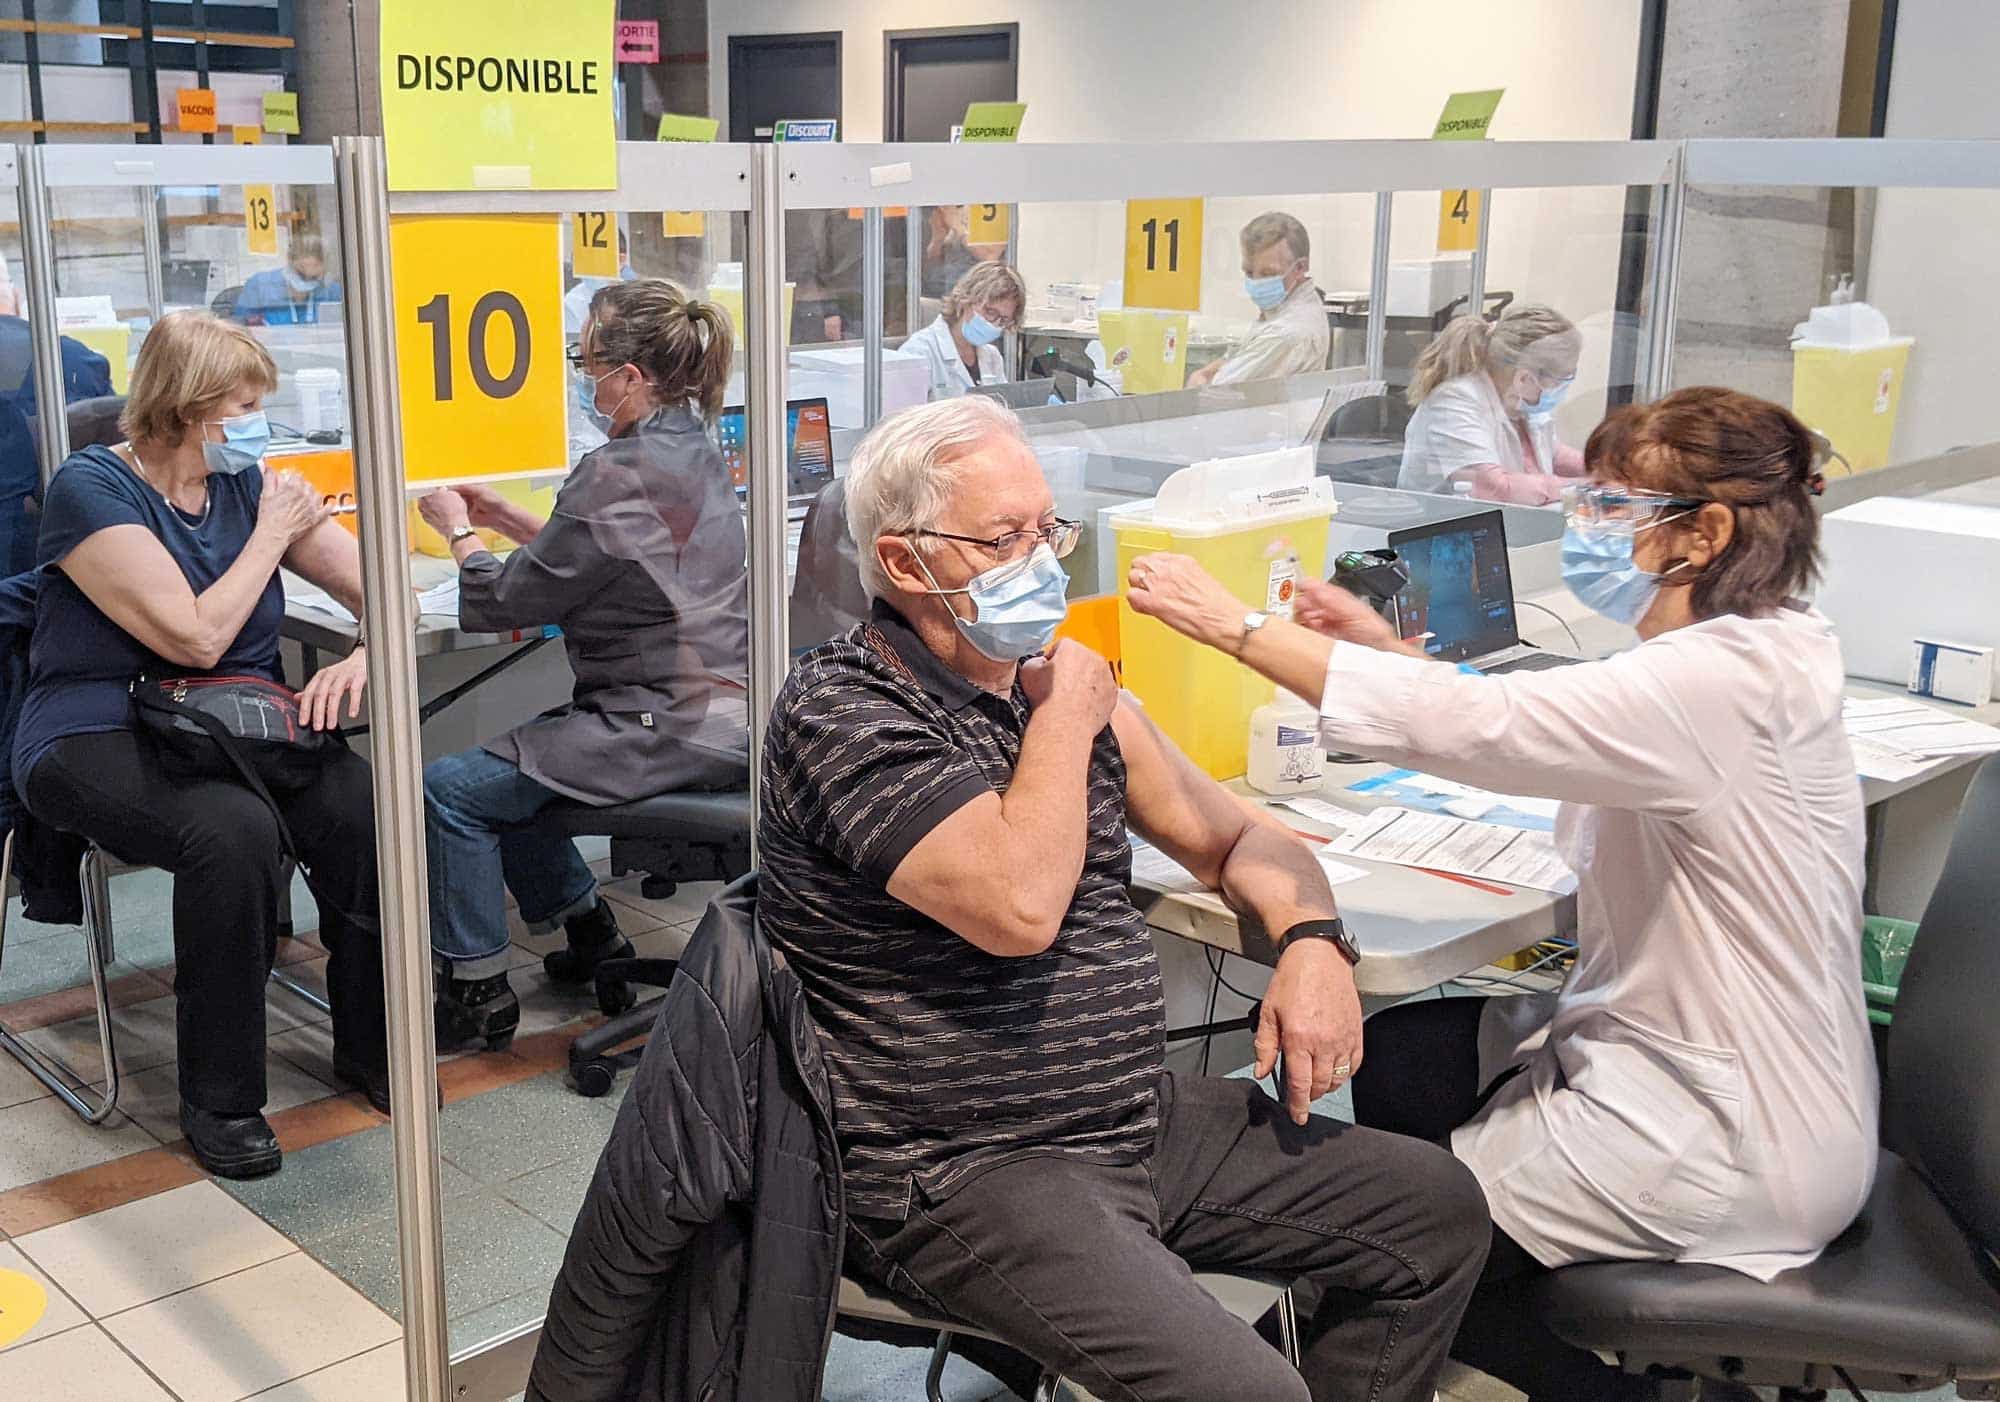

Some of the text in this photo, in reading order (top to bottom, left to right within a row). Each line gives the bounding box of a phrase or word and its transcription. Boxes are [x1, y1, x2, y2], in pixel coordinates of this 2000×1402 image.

[619, 26, 656, 37] ORTIE
[397, 54, 598, 94] DISPONIBLE
[964, 126, 1016, 138] DISPONIBLE
[249, 197, 269, 231] 13
[1451, 189, 1470, 224] 4
[578, 211, 607, 248] 12
[1142, 218, 1179, 271] 11
[417, 290, 531, 401] 10
